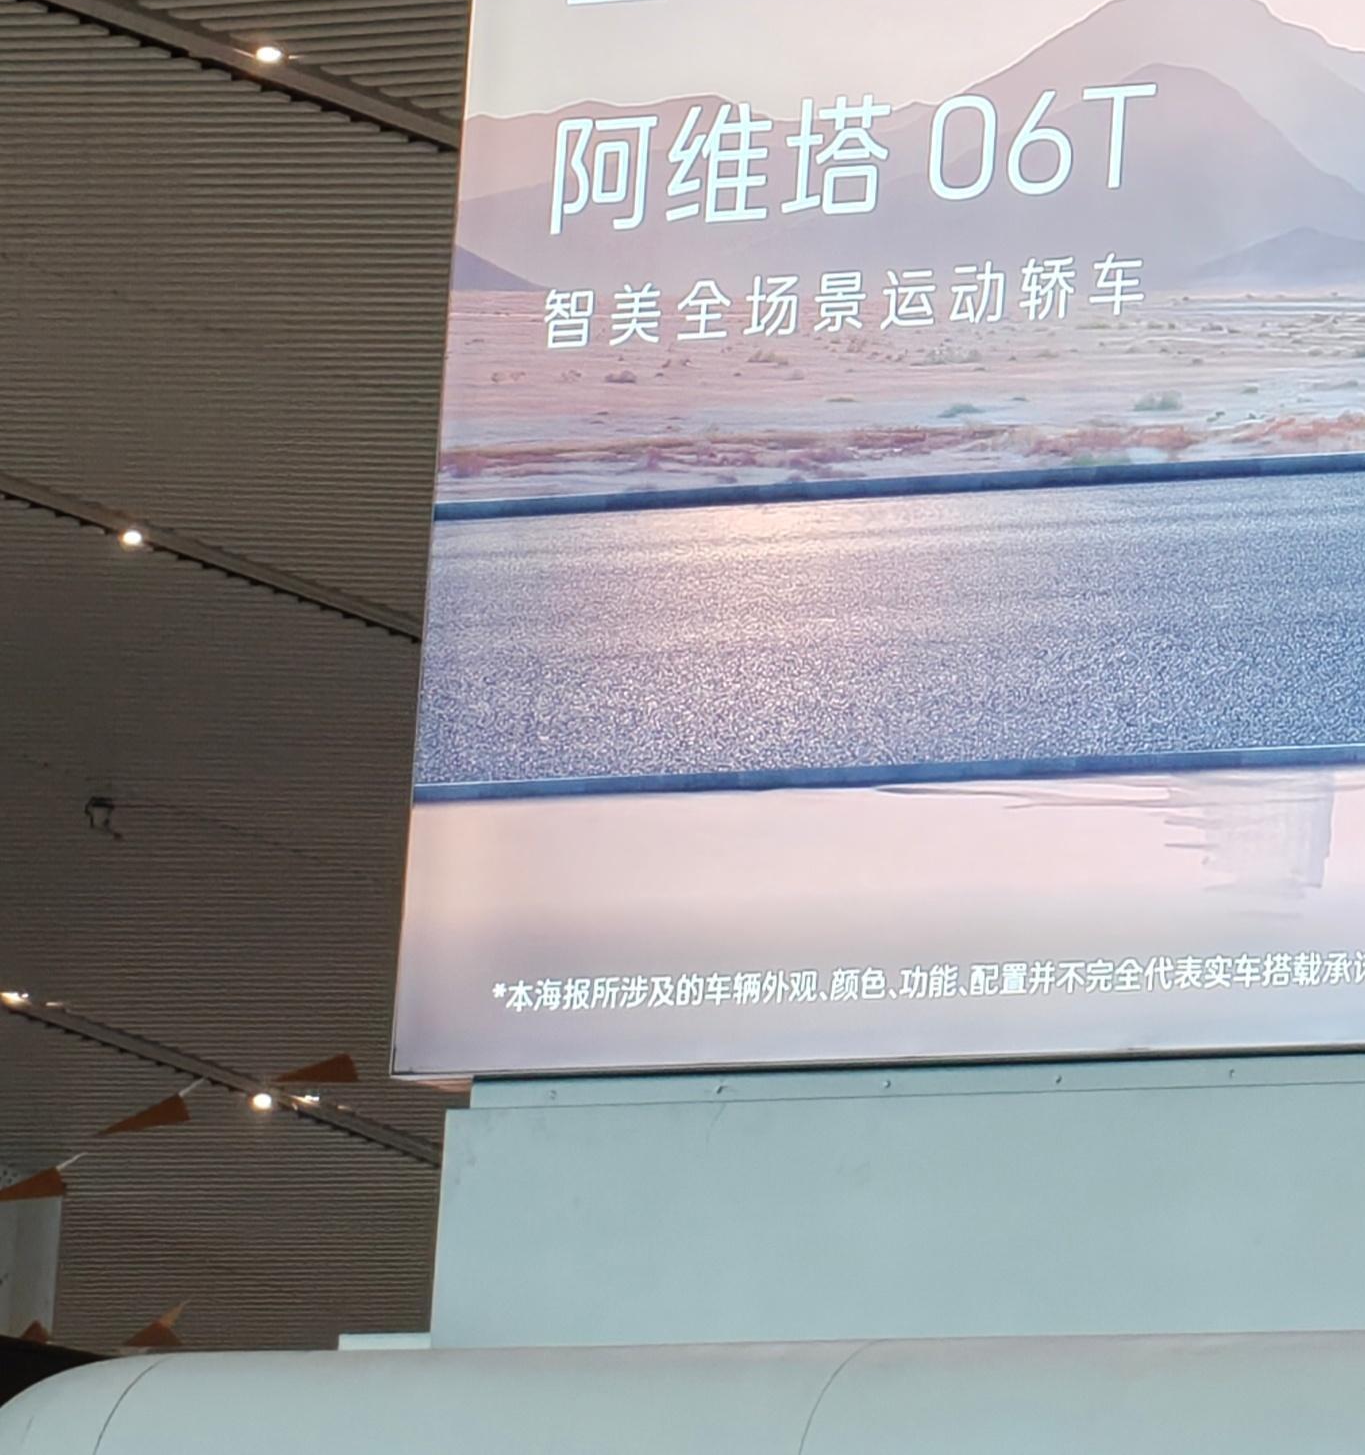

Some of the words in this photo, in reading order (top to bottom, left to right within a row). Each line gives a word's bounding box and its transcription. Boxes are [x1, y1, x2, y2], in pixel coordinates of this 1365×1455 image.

[549, 94, 892, 235] 阿维塔
[928, 83, 1158, 201] 06T
[543, 252, 1146, 350] 智美全场景运动轿车
